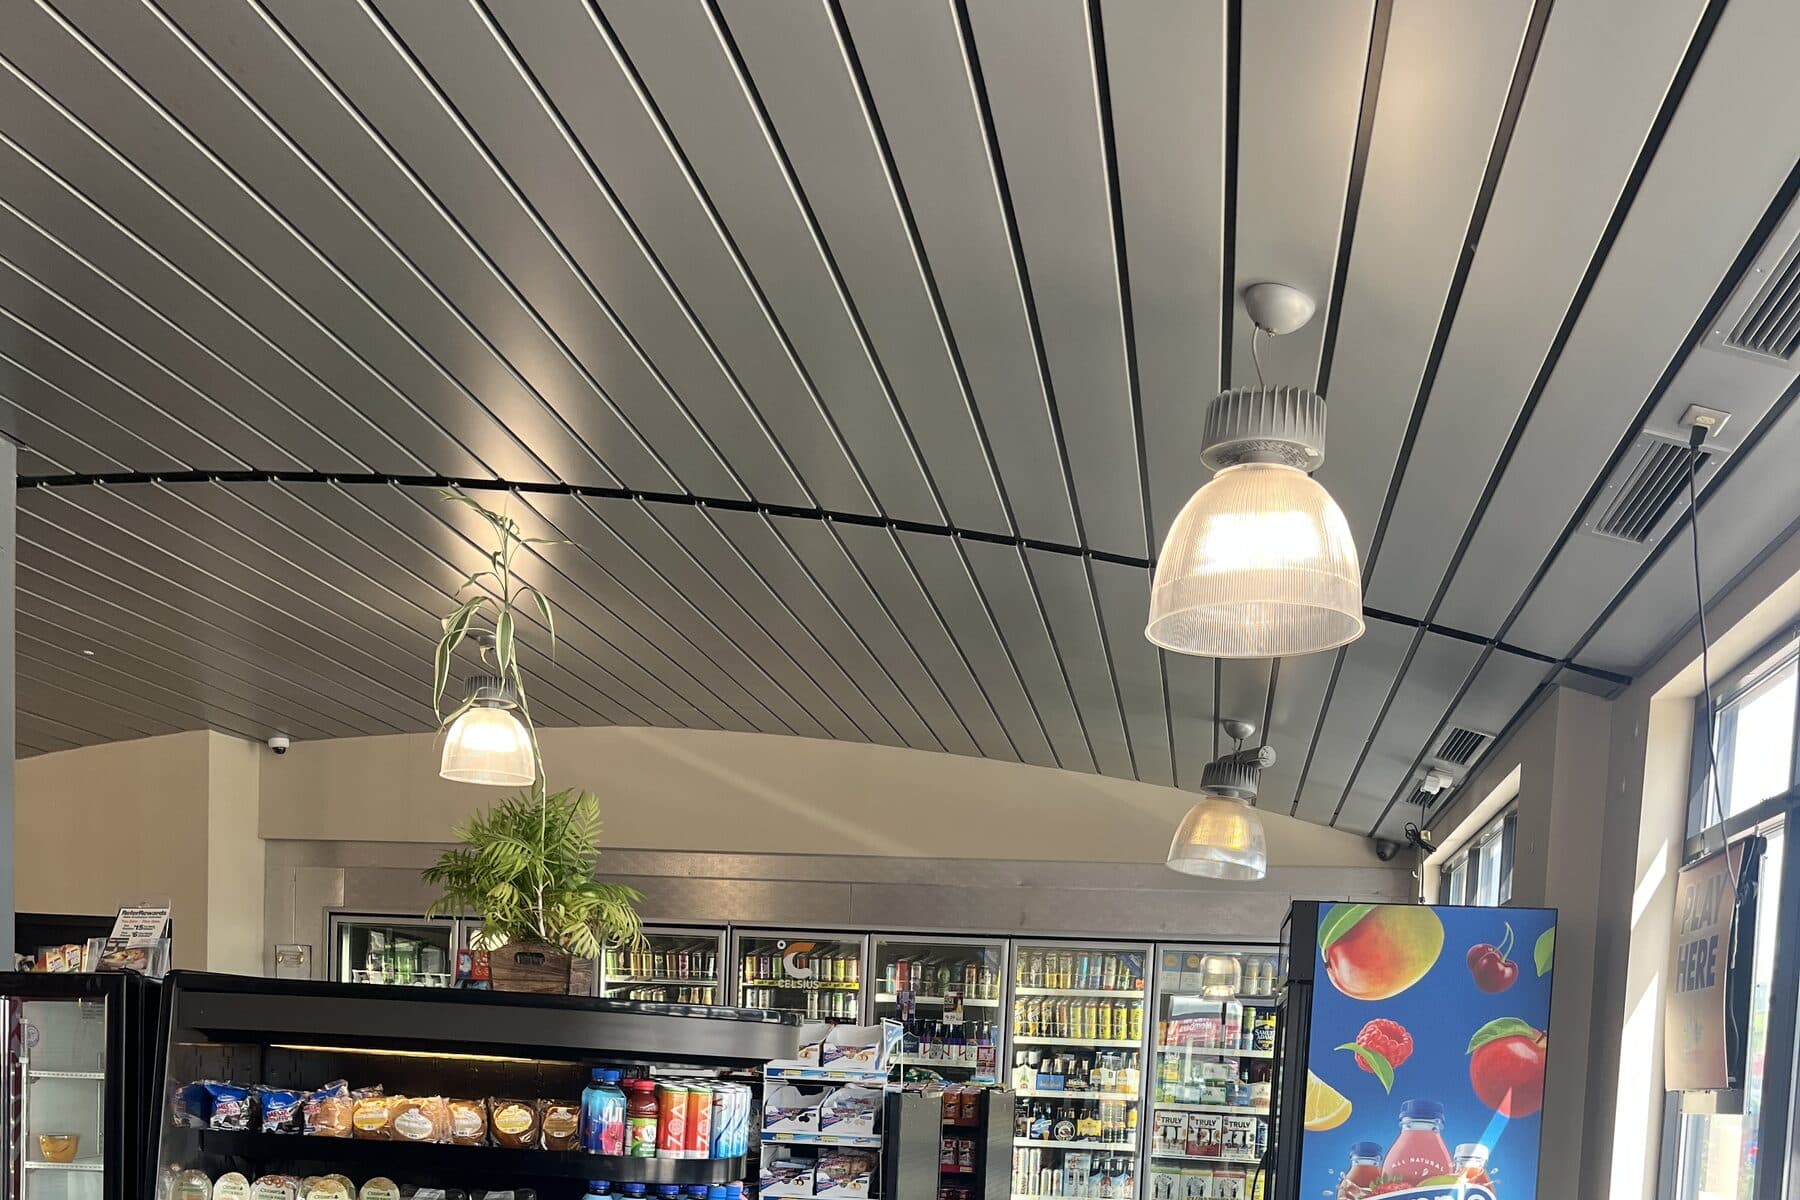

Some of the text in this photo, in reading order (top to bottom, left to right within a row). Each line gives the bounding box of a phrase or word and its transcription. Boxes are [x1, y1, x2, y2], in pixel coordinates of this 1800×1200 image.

[1680, 872, 1728, 935] PLAY
[1676, 934, 1719, 993] HERE
[777, 979, 820, 989] CELSIUS
[668, 1103, 685, 1147] ZOA
[1160, 1116, 1182, 1124] TRULY
[1195, 1119, 1217, 1127] TRULY
[1410, 1157, 1444, 1172] NATURAL
